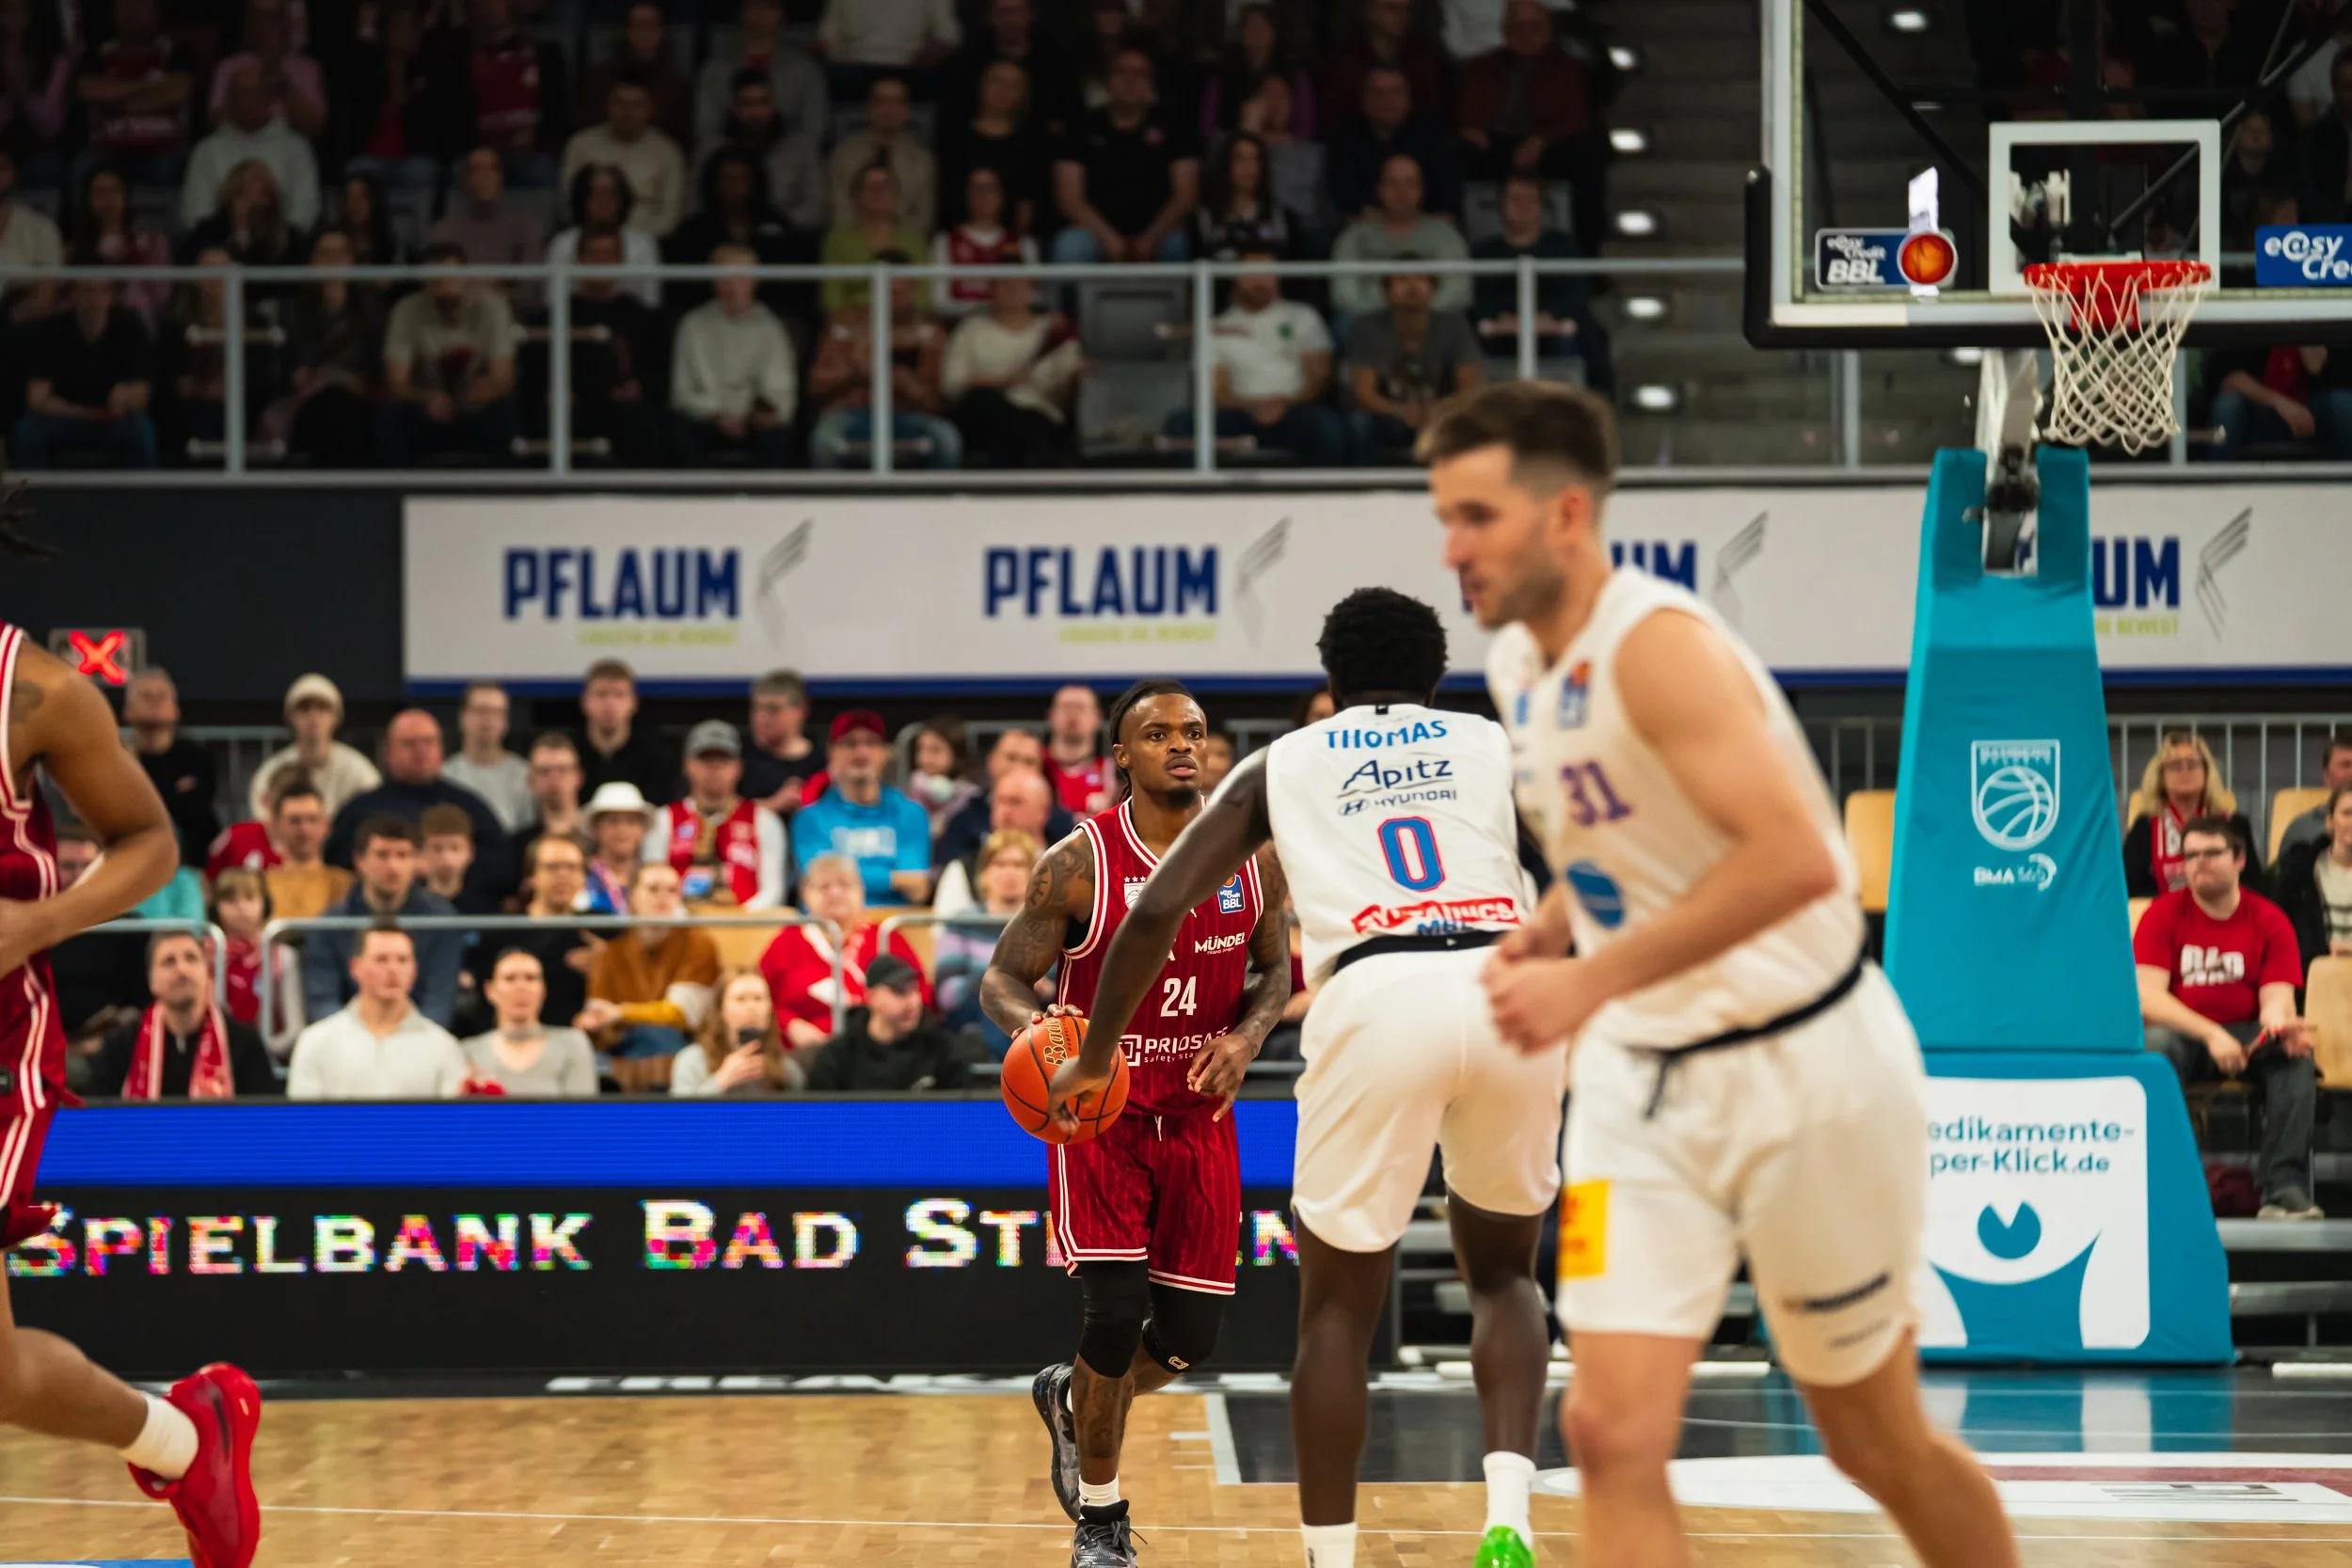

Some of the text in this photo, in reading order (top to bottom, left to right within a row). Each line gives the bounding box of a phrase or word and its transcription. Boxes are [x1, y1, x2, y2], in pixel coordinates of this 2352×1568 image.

[1827, 259, 1885, 284] BBL
[2301, 254, 2352, 280] Cre
[503, 546, 739, 620] PFLAUM
[983, 545, 1218, 617] PFLAUM
[1326, 720, 1448, 749] THOMAS
[1341, 758, 1454, 790] Apitz
[1374, 788, 1457, 809] HYUNDAI
[1559, 760, 1633, 827] 31
[1377, 816, 1446, 893] 0
[1223, 898, 1242, 910] BBL
[1195, 932, 1246, 954] MÜNDEL
[1160, 976, 1198, 1018] 24
[1931, 1147, 2110, 1179] per-Klick.de
